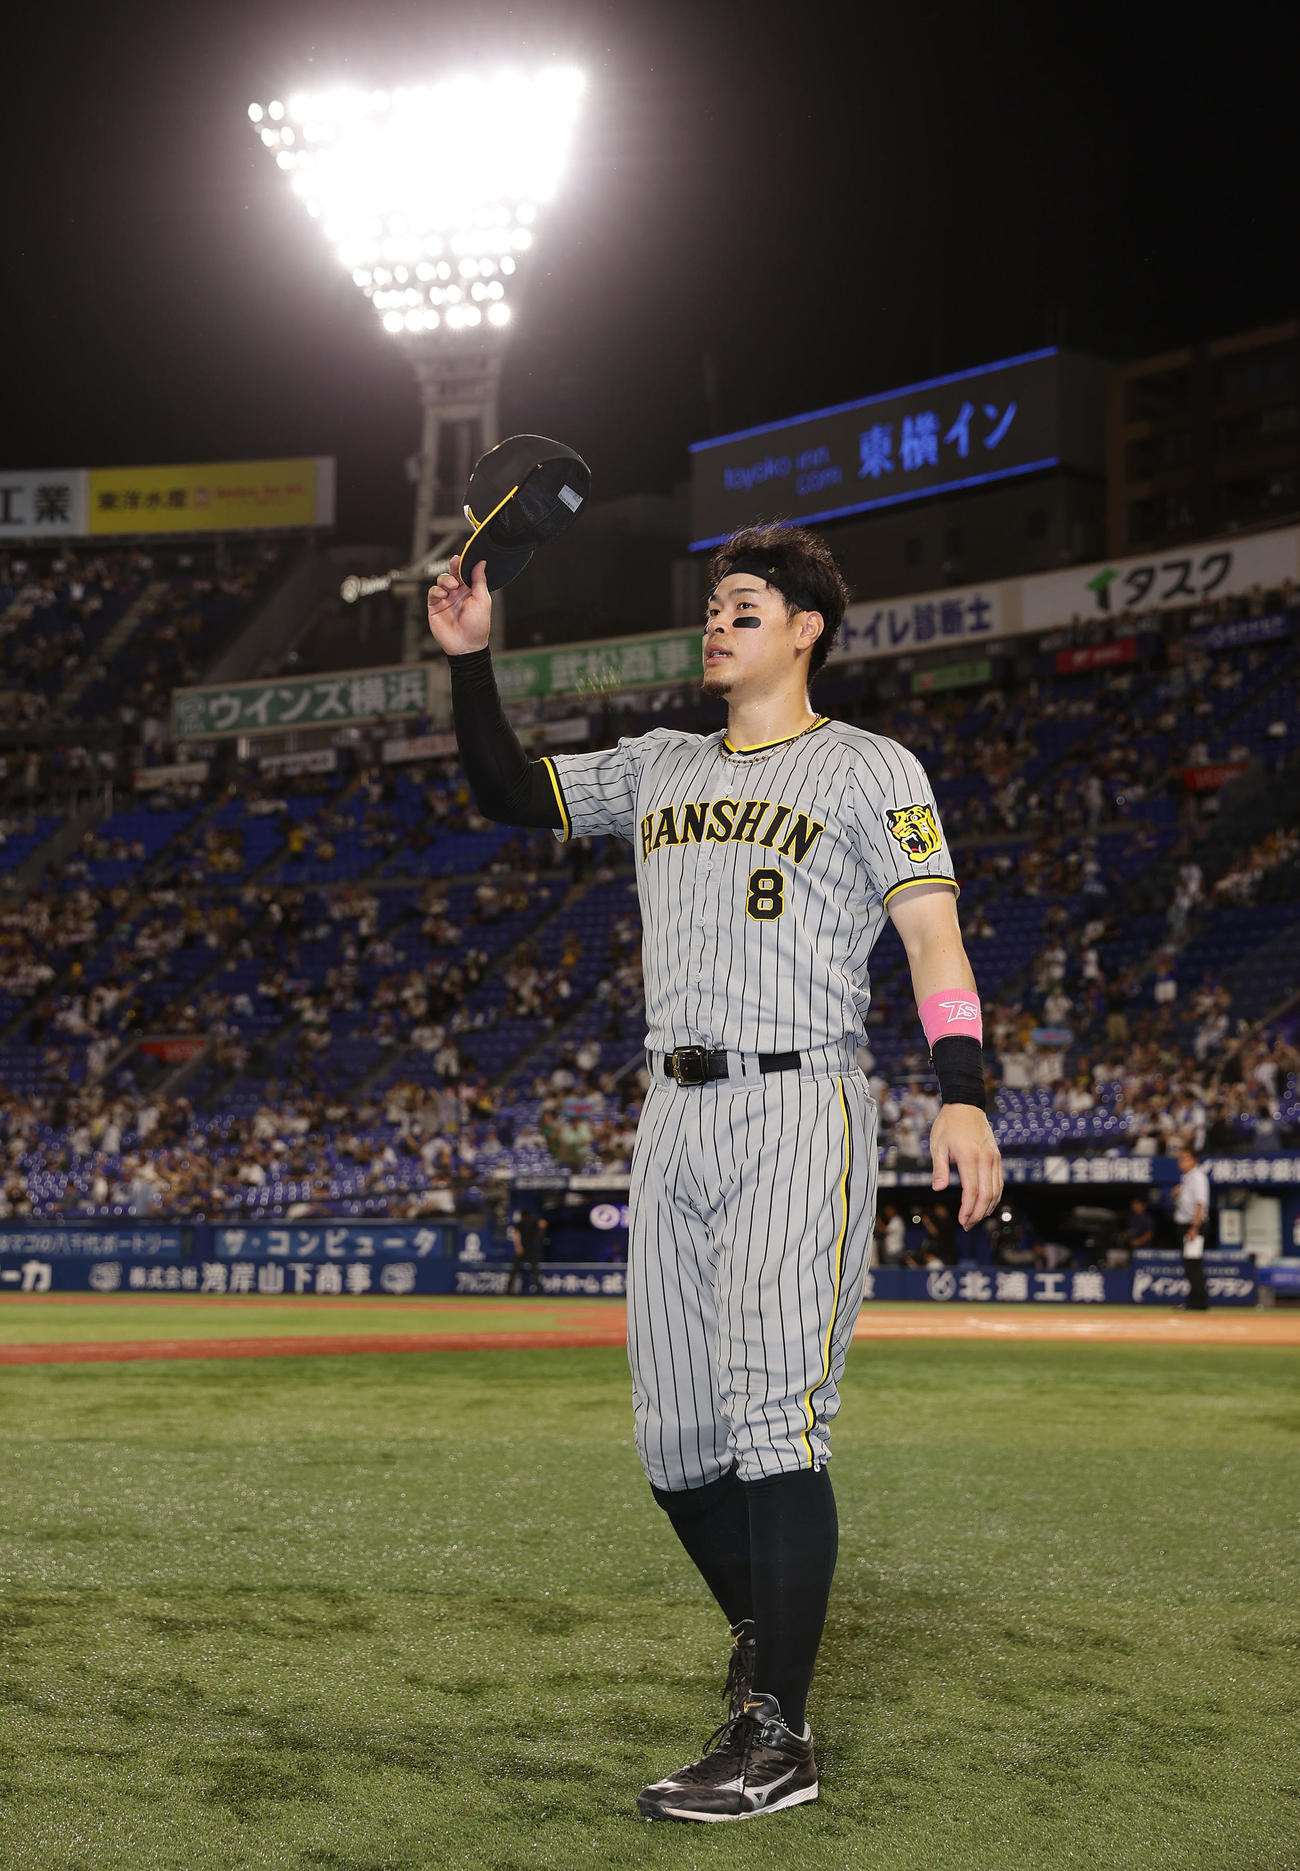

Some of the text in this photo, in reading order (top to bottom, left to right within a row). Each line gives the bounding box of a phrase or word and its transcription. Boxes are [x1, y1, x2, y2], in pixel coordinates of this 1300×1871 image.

[858, 401, 1017, 480] 東横イン
[0, 484, 70, 524] 工業
[1124, 552, 1233, 606] タスク
[209, 669, 428, 729] ウインズ横浜
[641, 798, 825, 865] HANSHIN
[746, 867, 786, 921] 8
[224, 1228, 437, 1256] ザ・コンピュータ
[129, 1265, 198, 1290] 株式会社
